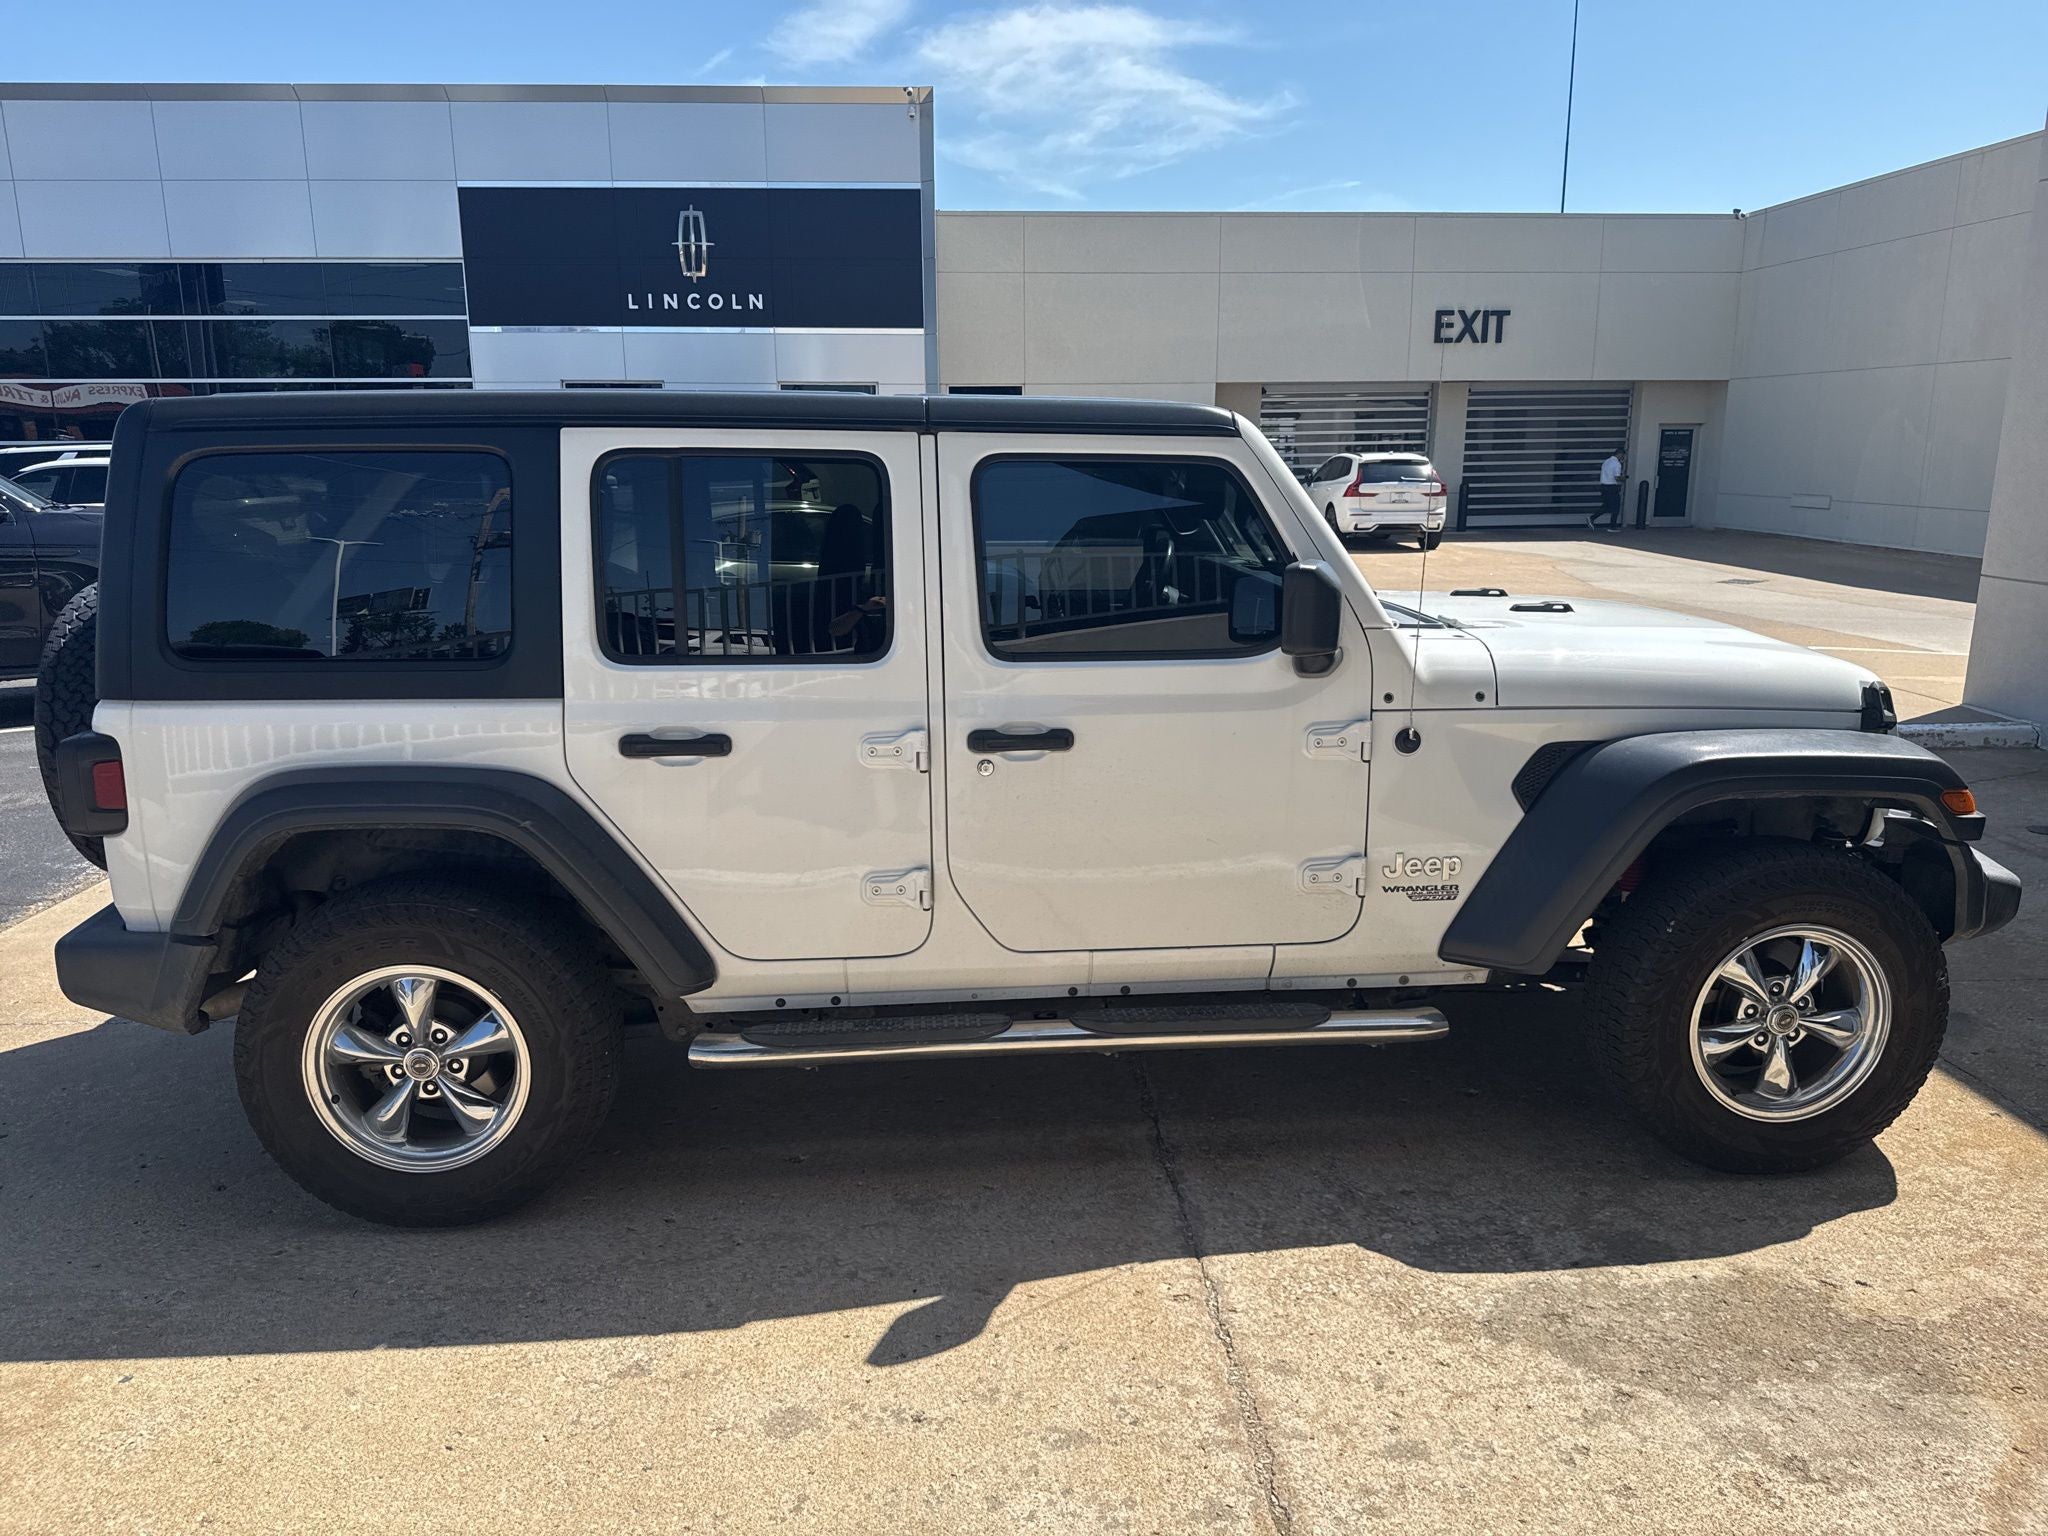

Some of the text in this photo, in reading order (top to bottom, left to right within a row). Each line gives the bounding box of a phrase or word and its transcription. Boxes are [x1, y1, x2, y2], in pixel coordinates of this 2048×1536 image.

[627, 293, 764, 310] LINCOLN
[1434, 310, 1511, 343] EXIT
[1382, 852, 1462, 881] Jeep
[1382, 884, 1459, 893] WRANGLER
